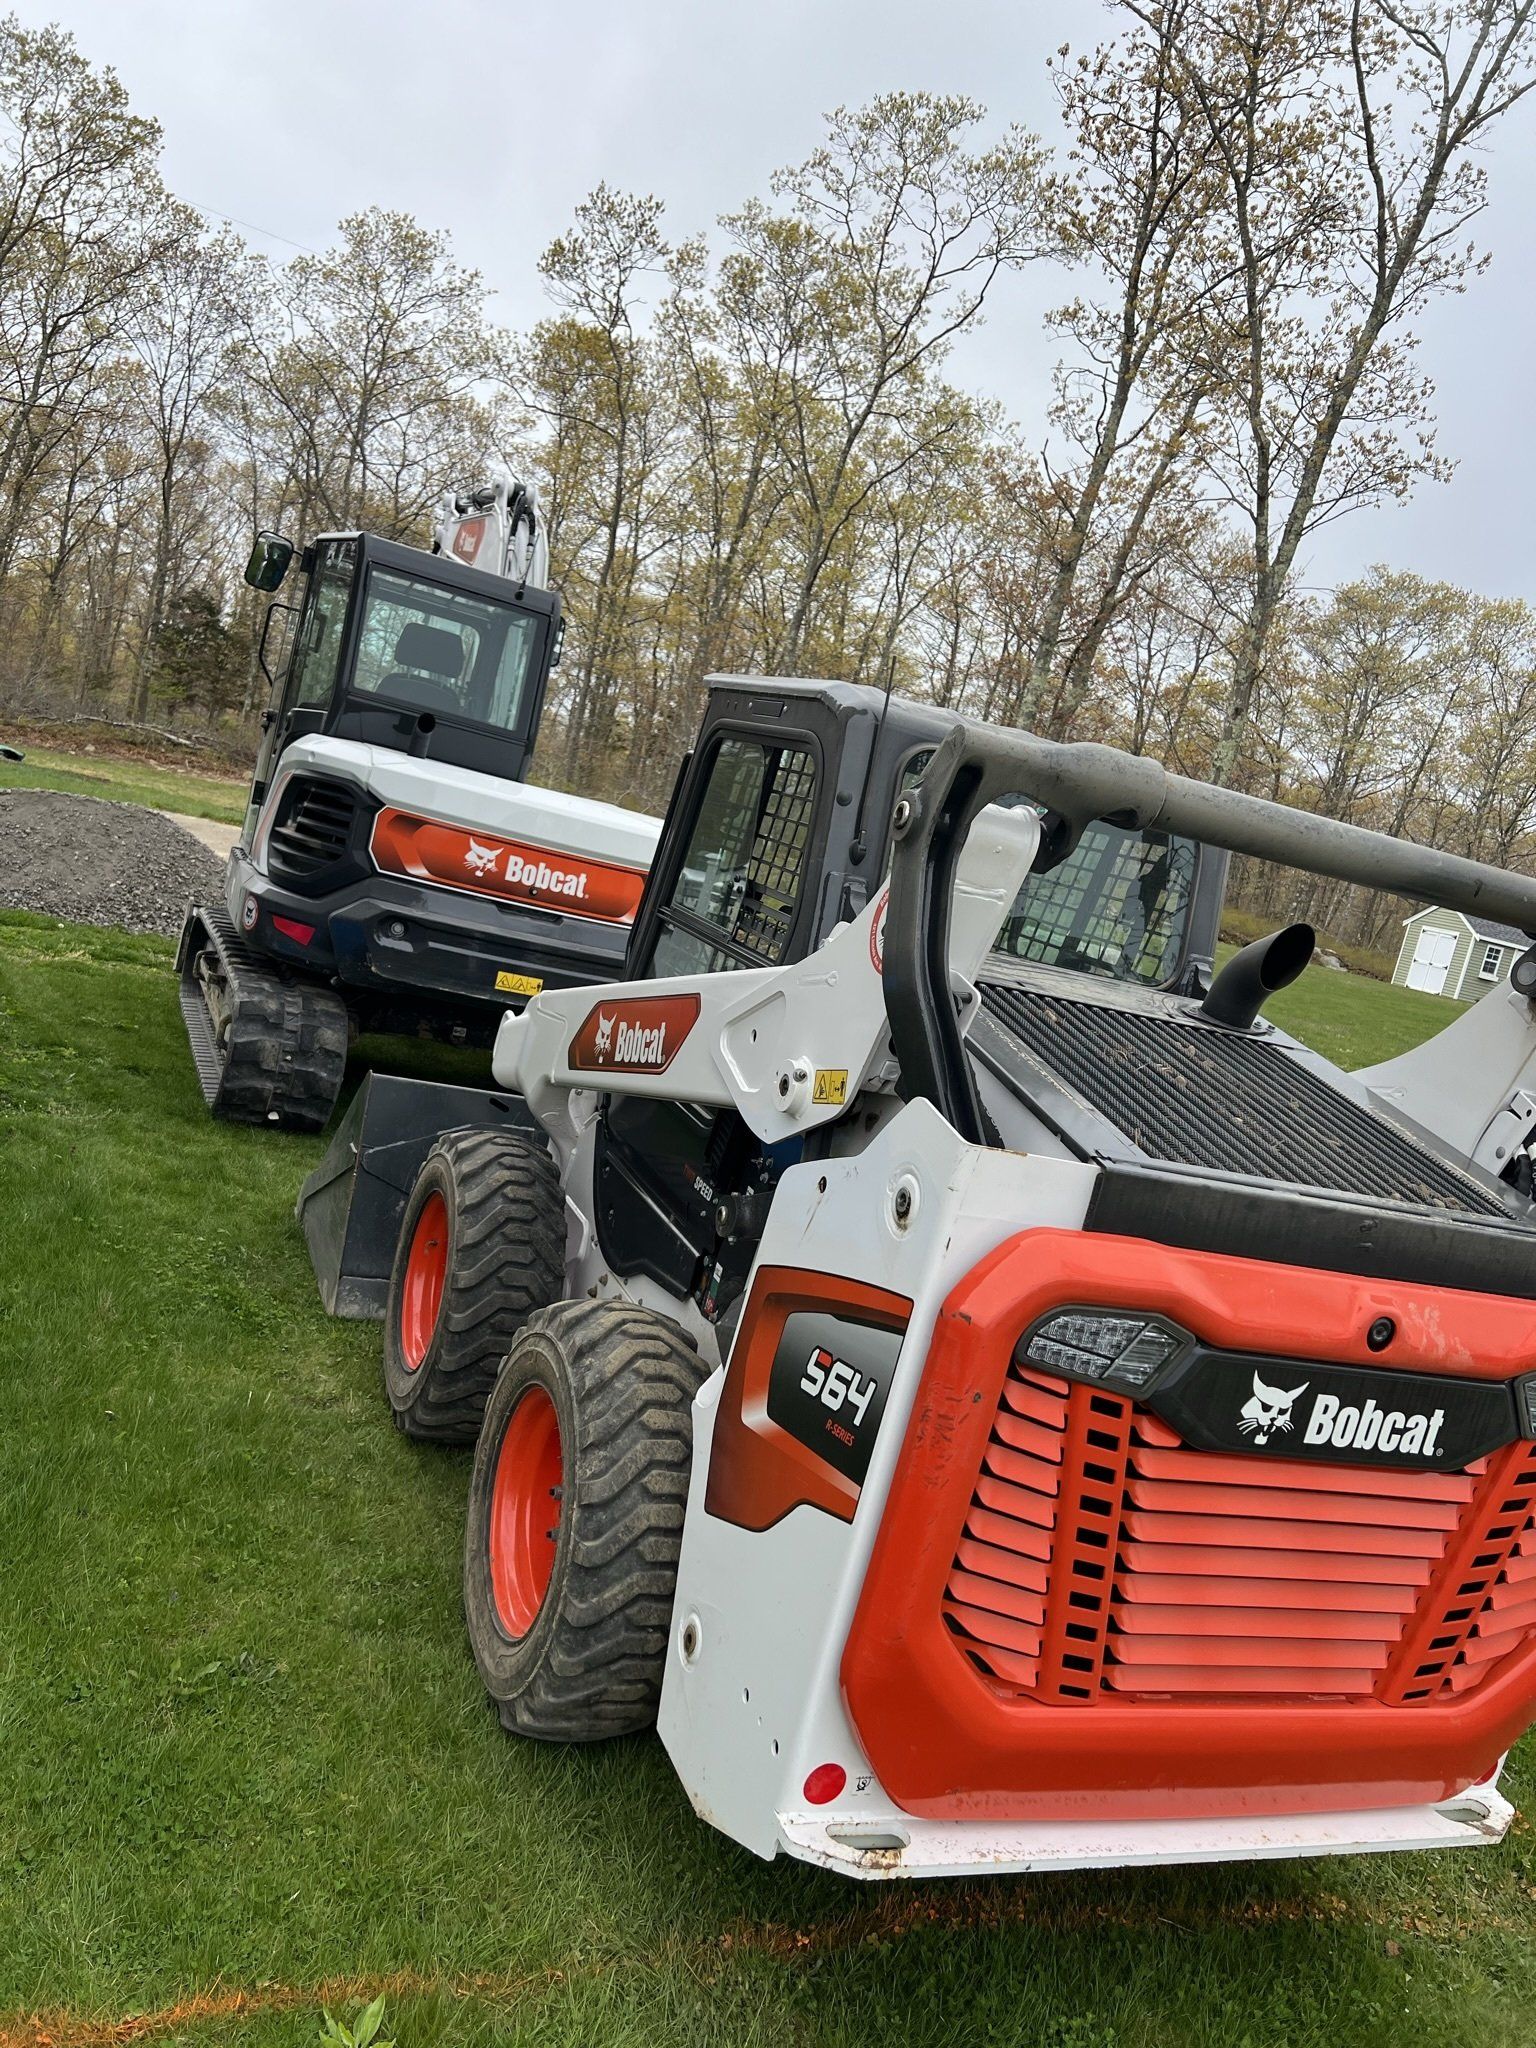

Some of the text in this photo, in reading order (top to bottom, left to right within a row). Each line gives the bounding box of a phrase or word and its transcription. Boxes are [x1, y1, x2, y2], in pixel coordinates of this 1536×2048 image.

[505, 855, 587, 898] Bobcat
[614, 1021, 666, 1064] Bobcat
[694, 1176, 713, 1201] SPEED
[801, 1348, 877, 1427] S64
[825, 1419, 855, 1447] R-SERIES
[1303, 1393, 1445, 1457] Bobcat
